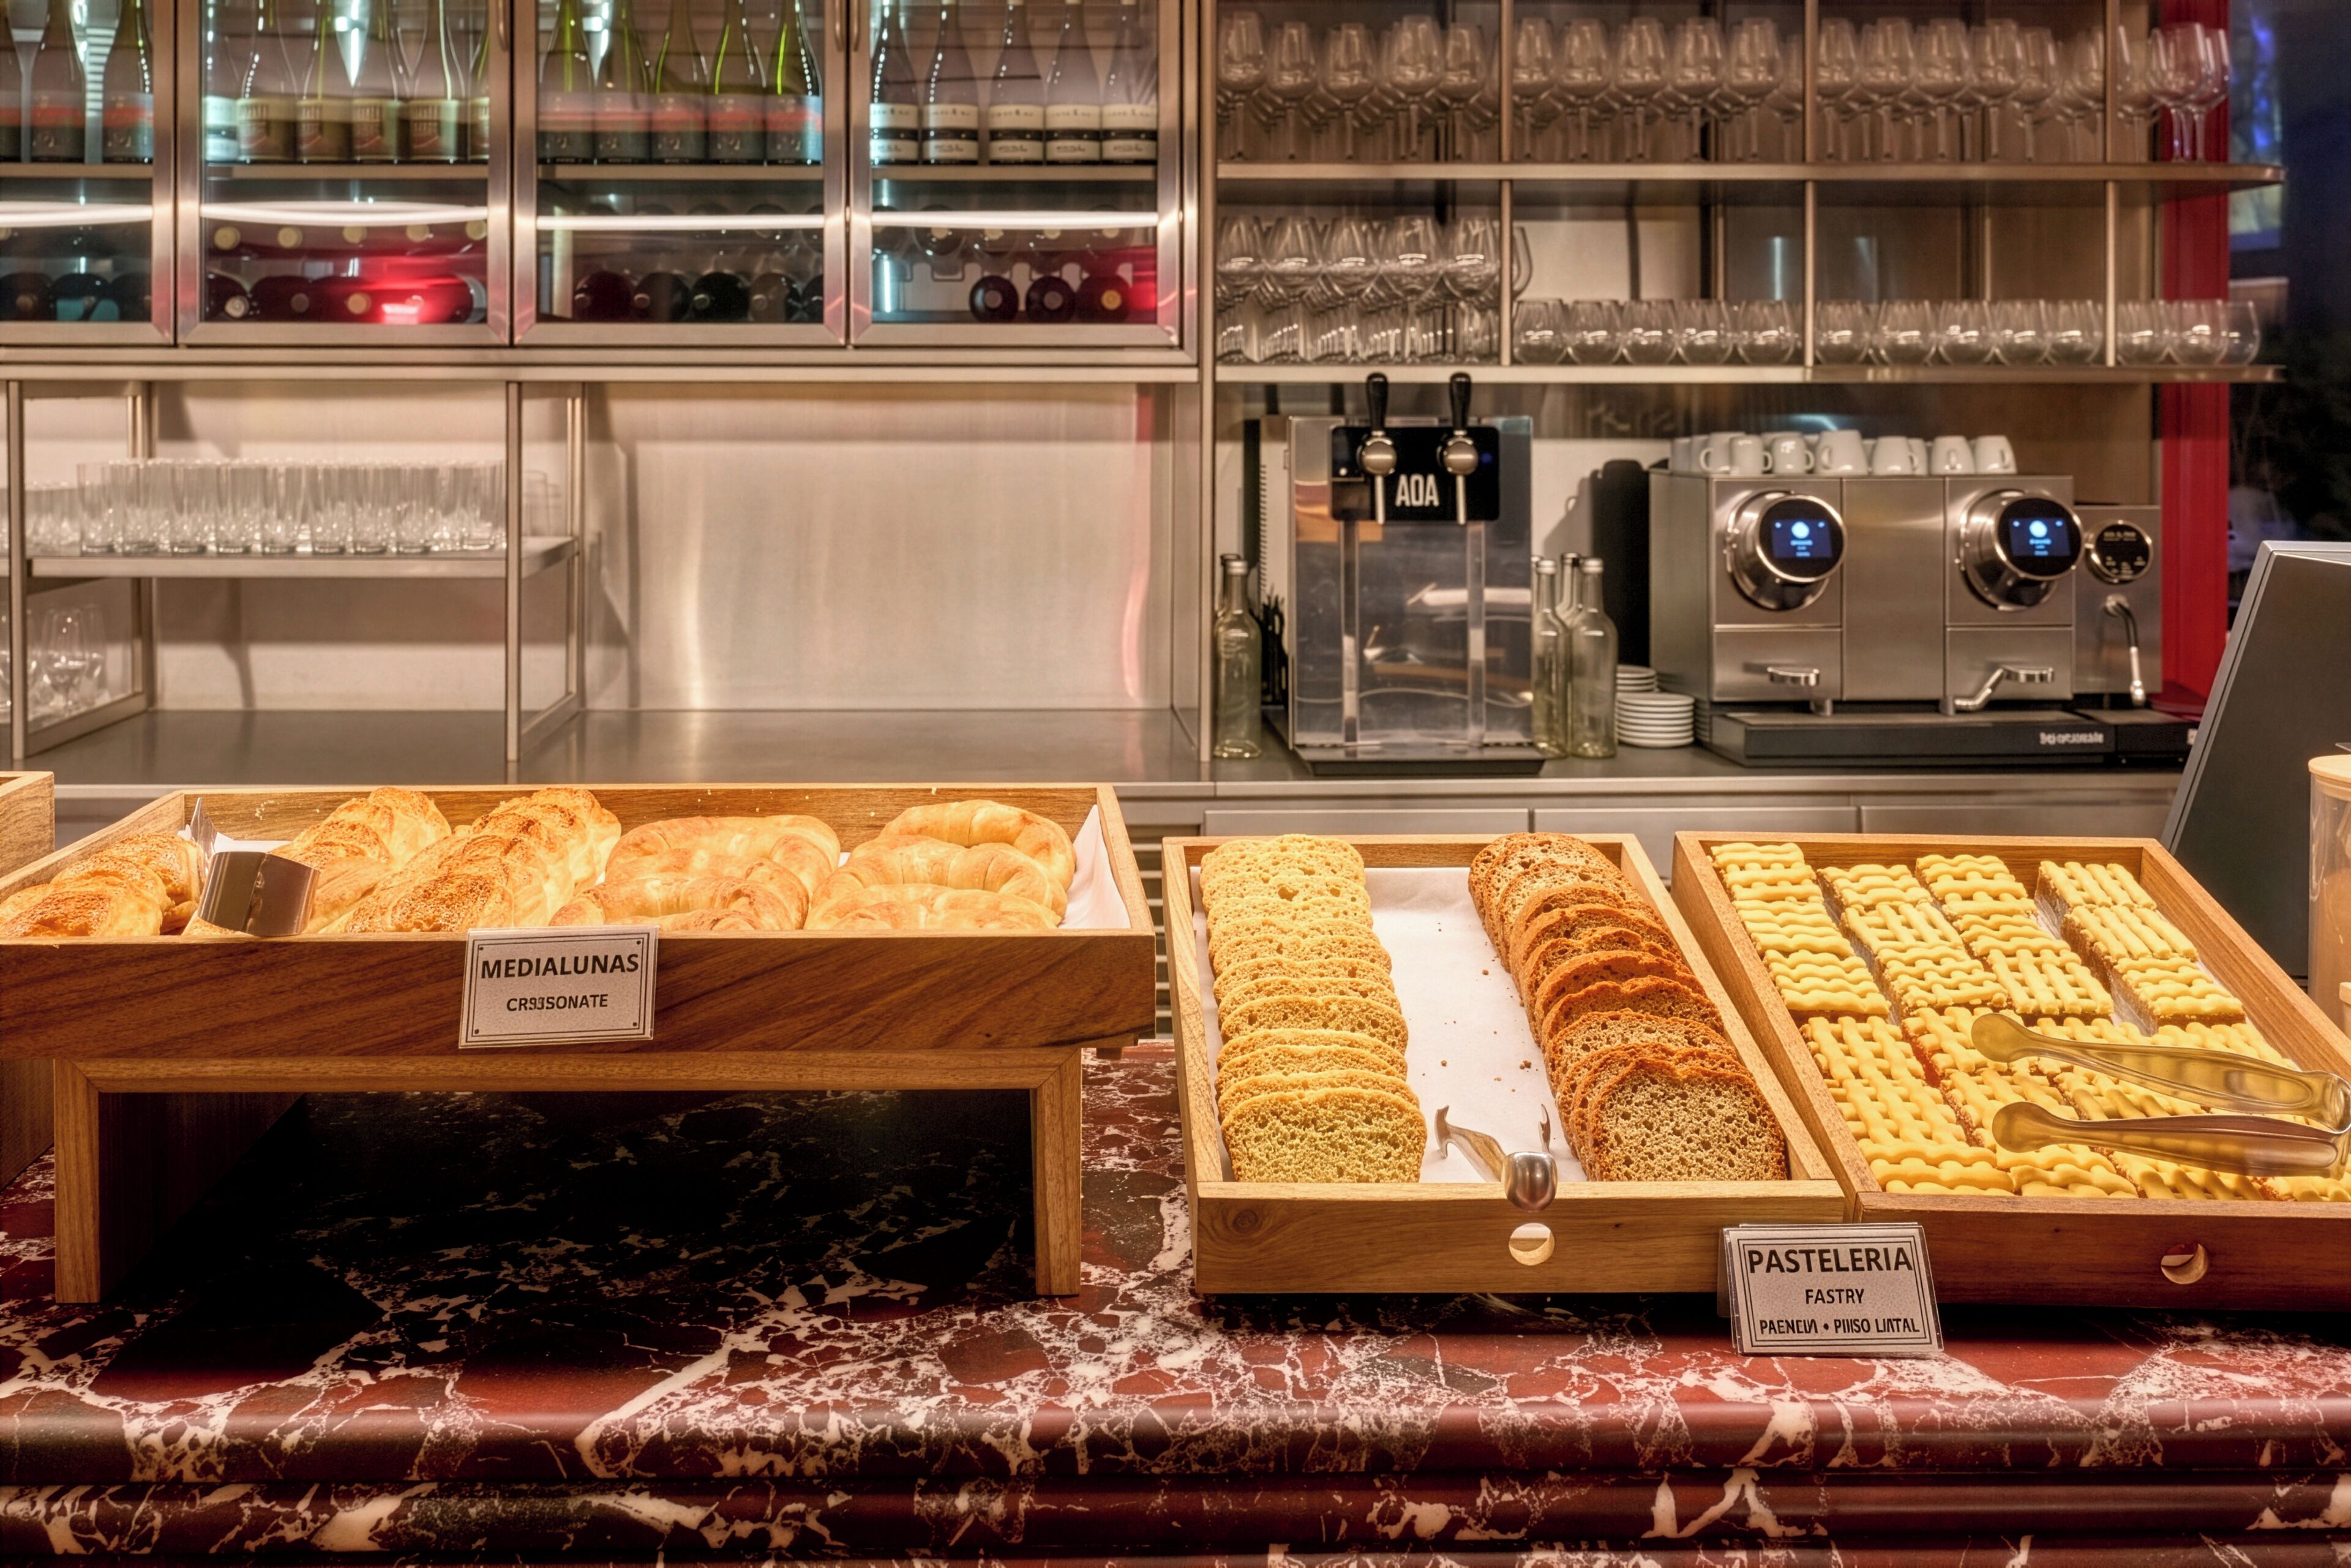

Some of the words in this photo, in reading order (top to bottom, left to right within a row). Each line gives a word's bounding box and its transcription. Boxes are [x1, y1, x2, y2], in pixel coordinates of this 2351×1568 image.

[1395, 473, 1439, 507] AOA
[481, 954, 639, 979] MEDIALUNAS
[1747, 1247, 1913, 1274] PASTELERIA
[1805, 1288, 1865, 1305] FASTRY
